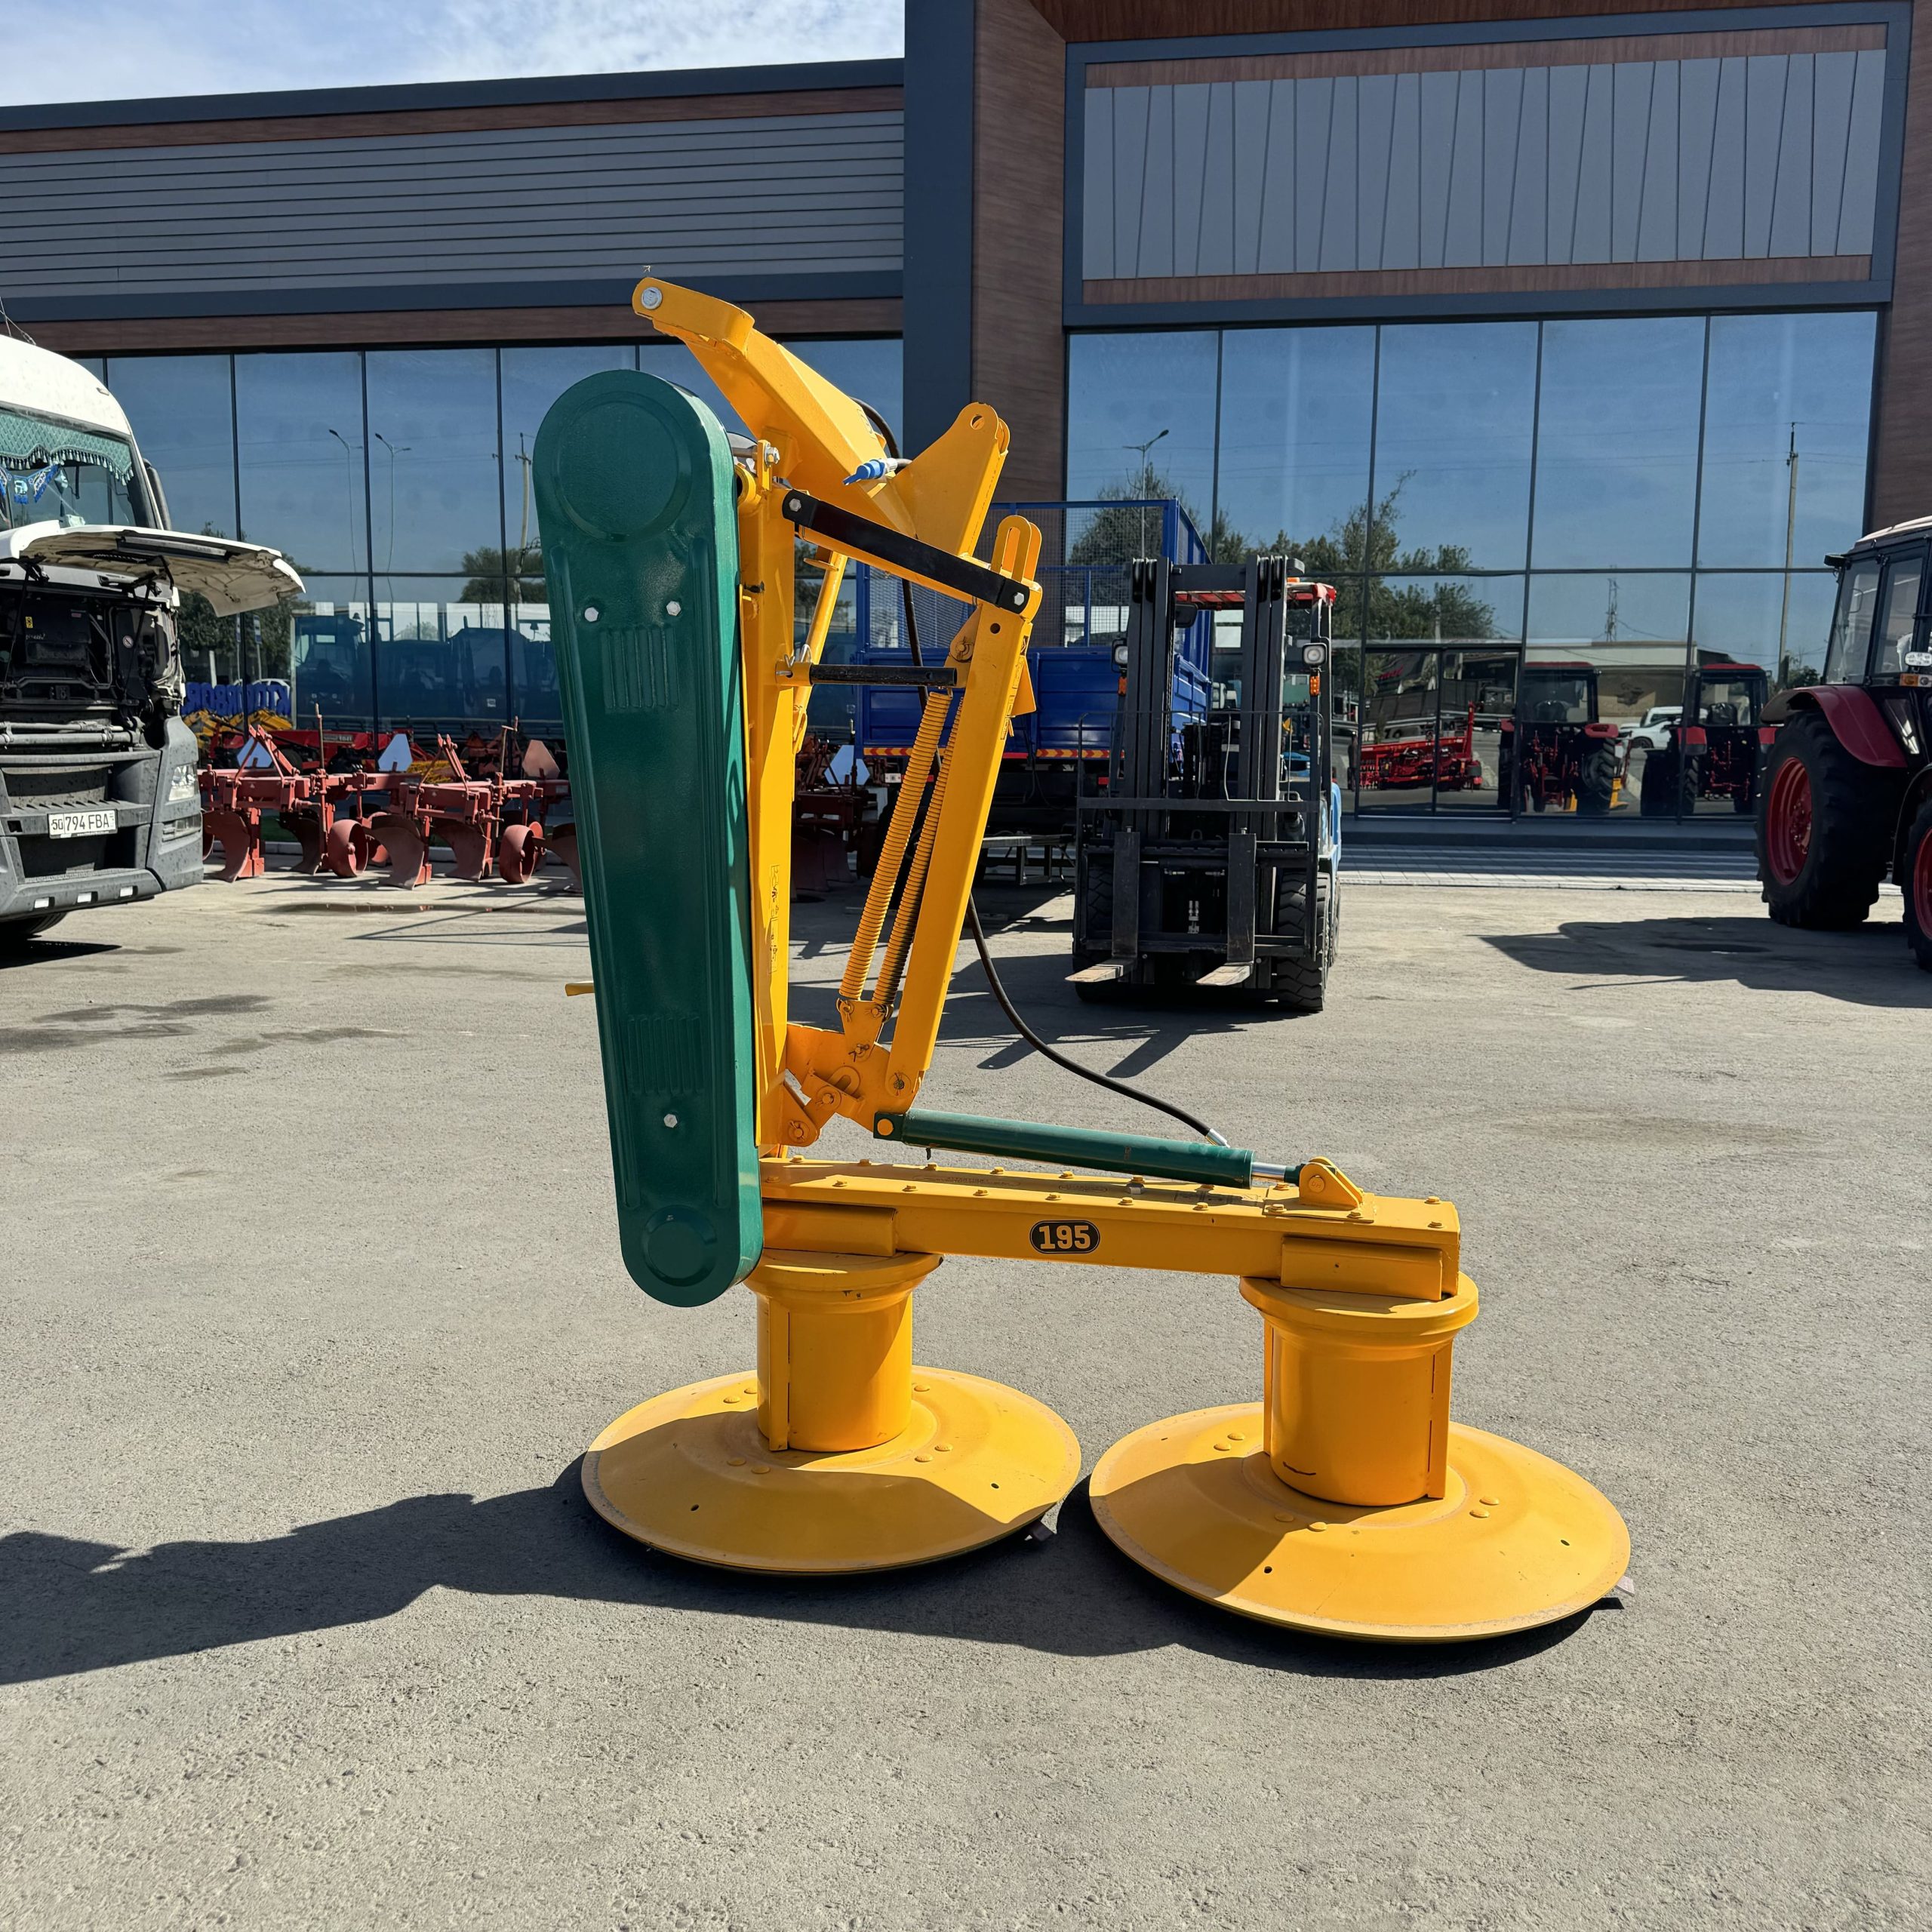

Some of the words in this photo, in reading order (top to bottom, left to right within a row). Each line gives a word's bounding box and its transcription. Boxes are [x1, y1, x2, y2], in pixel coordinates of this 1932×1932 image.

[52, 819, 63, 830] 50
[65, 816, 85, 831] 794
[88, 814, 109, 829] FBA
[1038, 1225, 1091, 1249] 195
